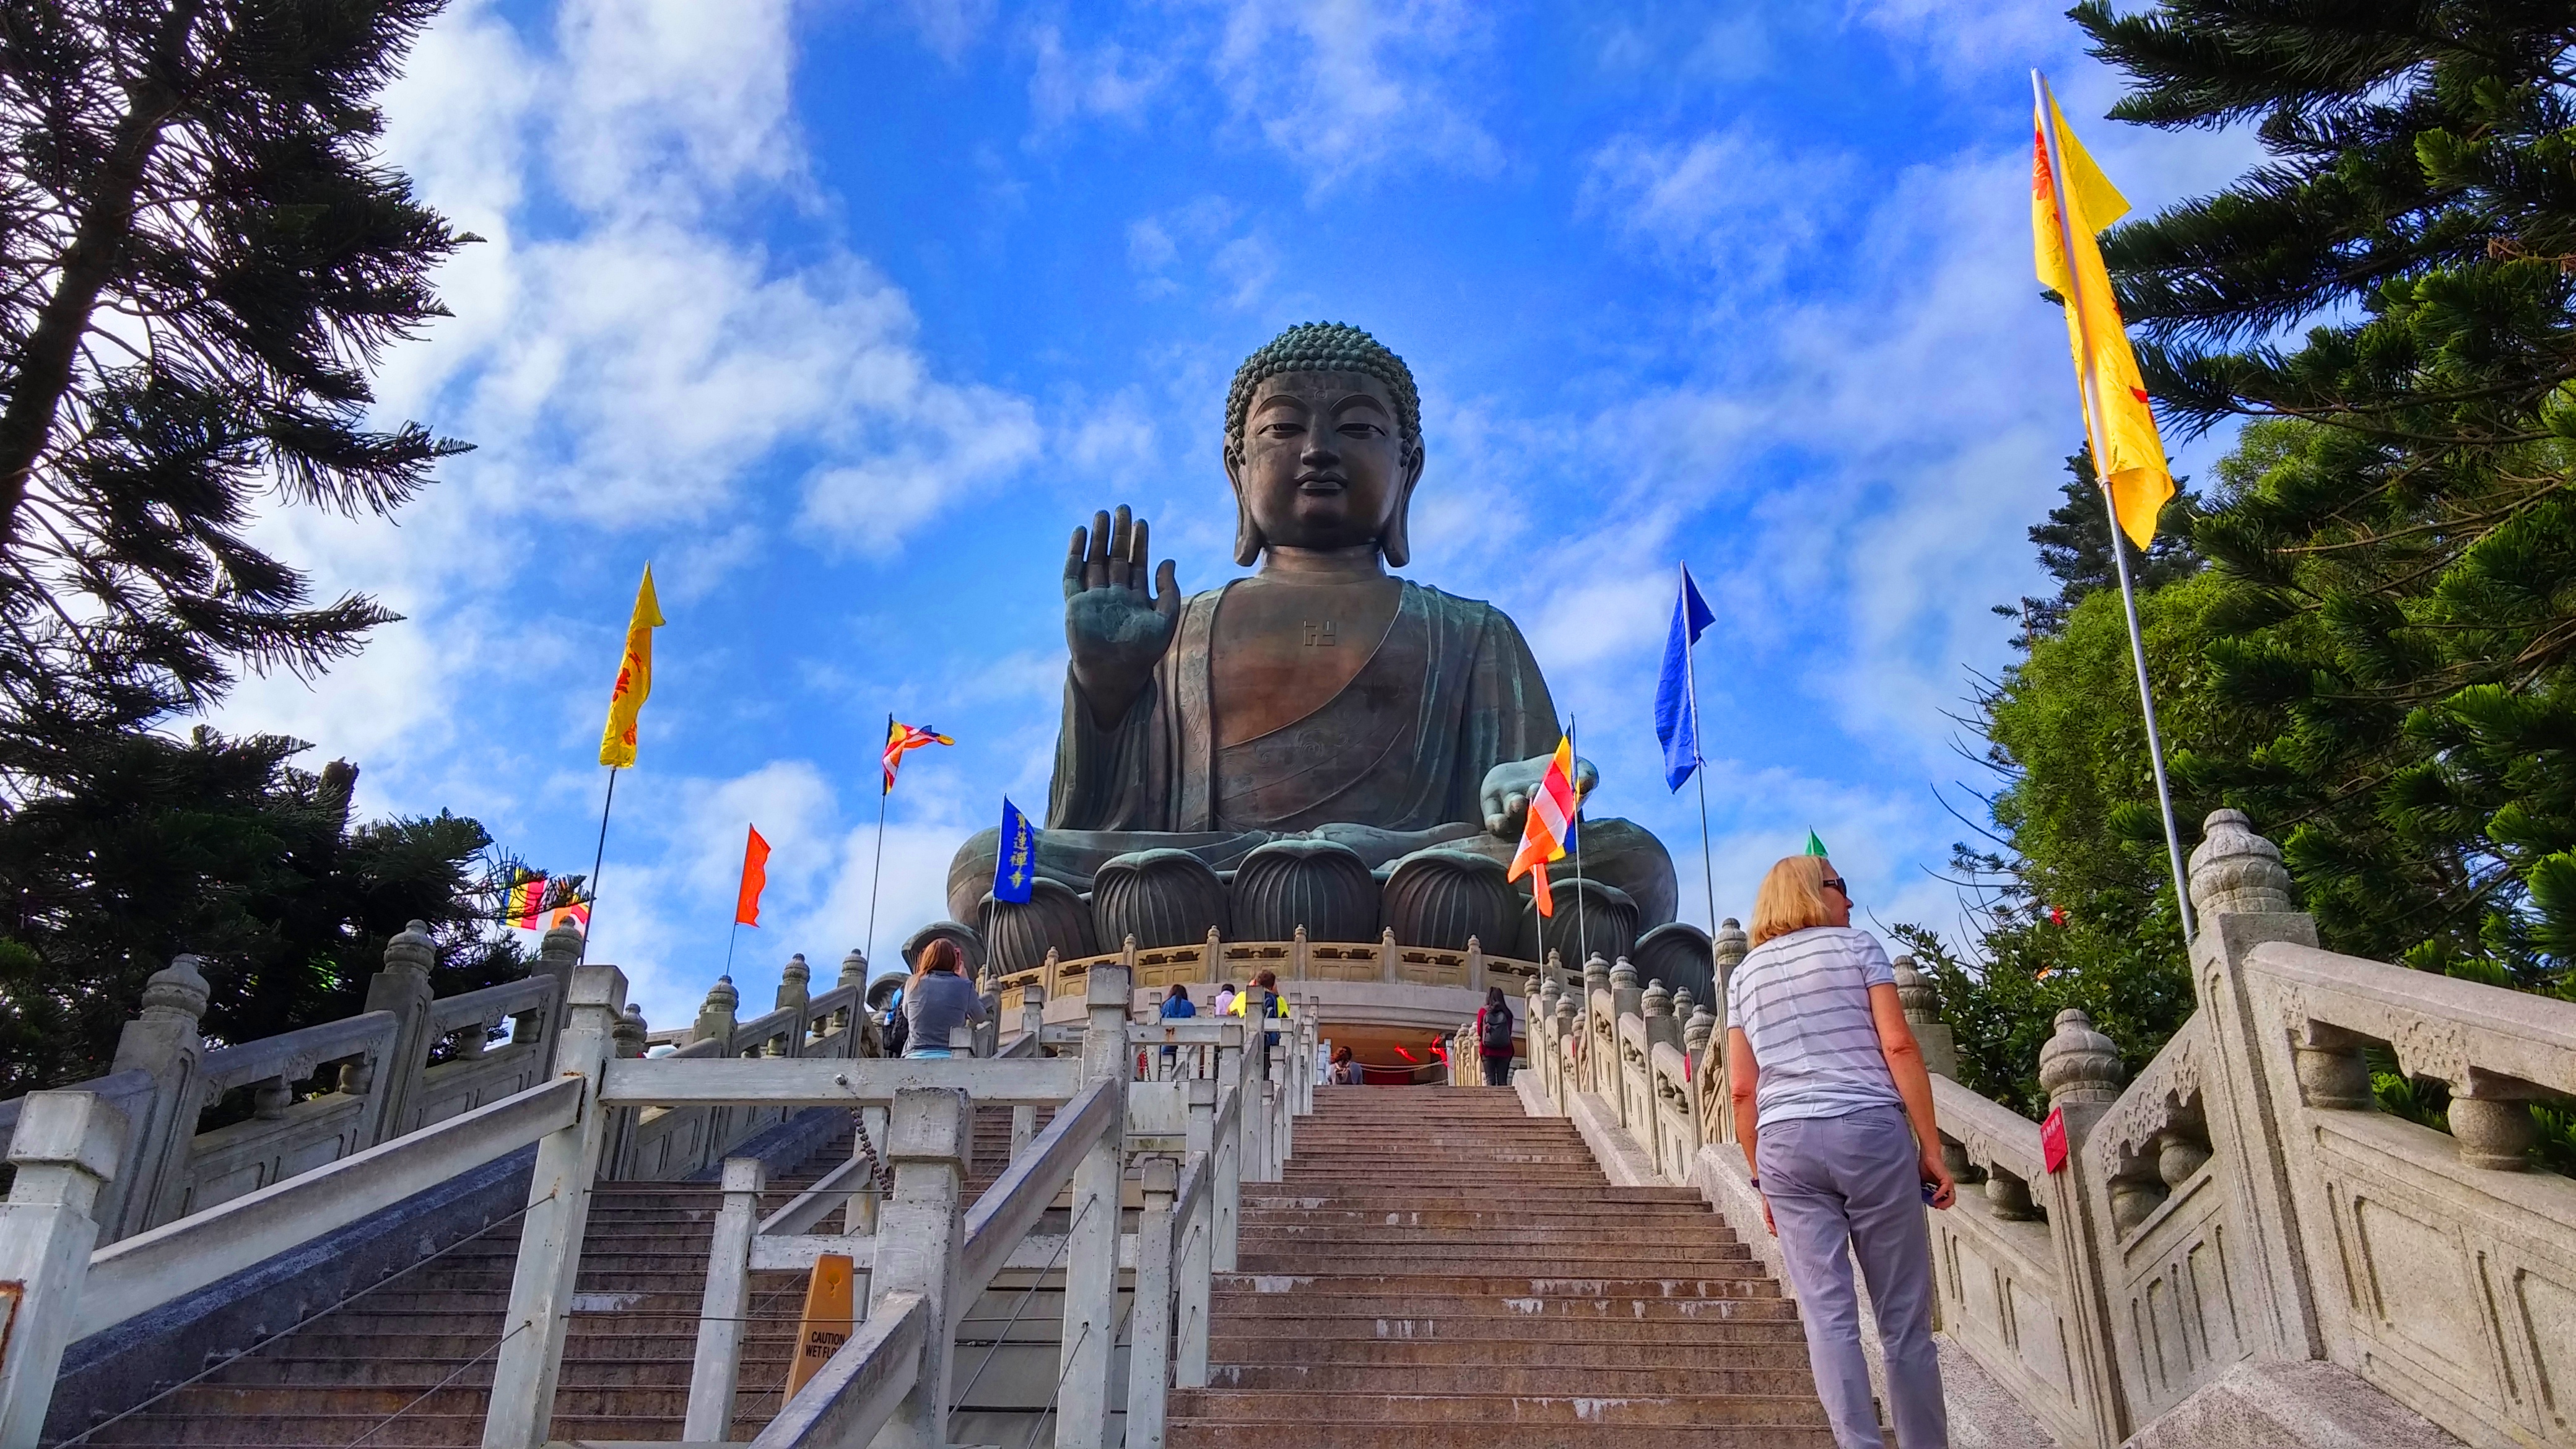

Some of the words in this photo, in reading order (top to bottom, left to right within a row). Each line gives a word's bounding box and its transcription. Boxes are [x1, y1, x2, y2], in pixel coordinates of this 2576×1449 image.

[812, 1331, 845, 1346] CAUTION
[806, 1344, 822, 1358] WET
[822, 1346, 837, 1359] FLO
